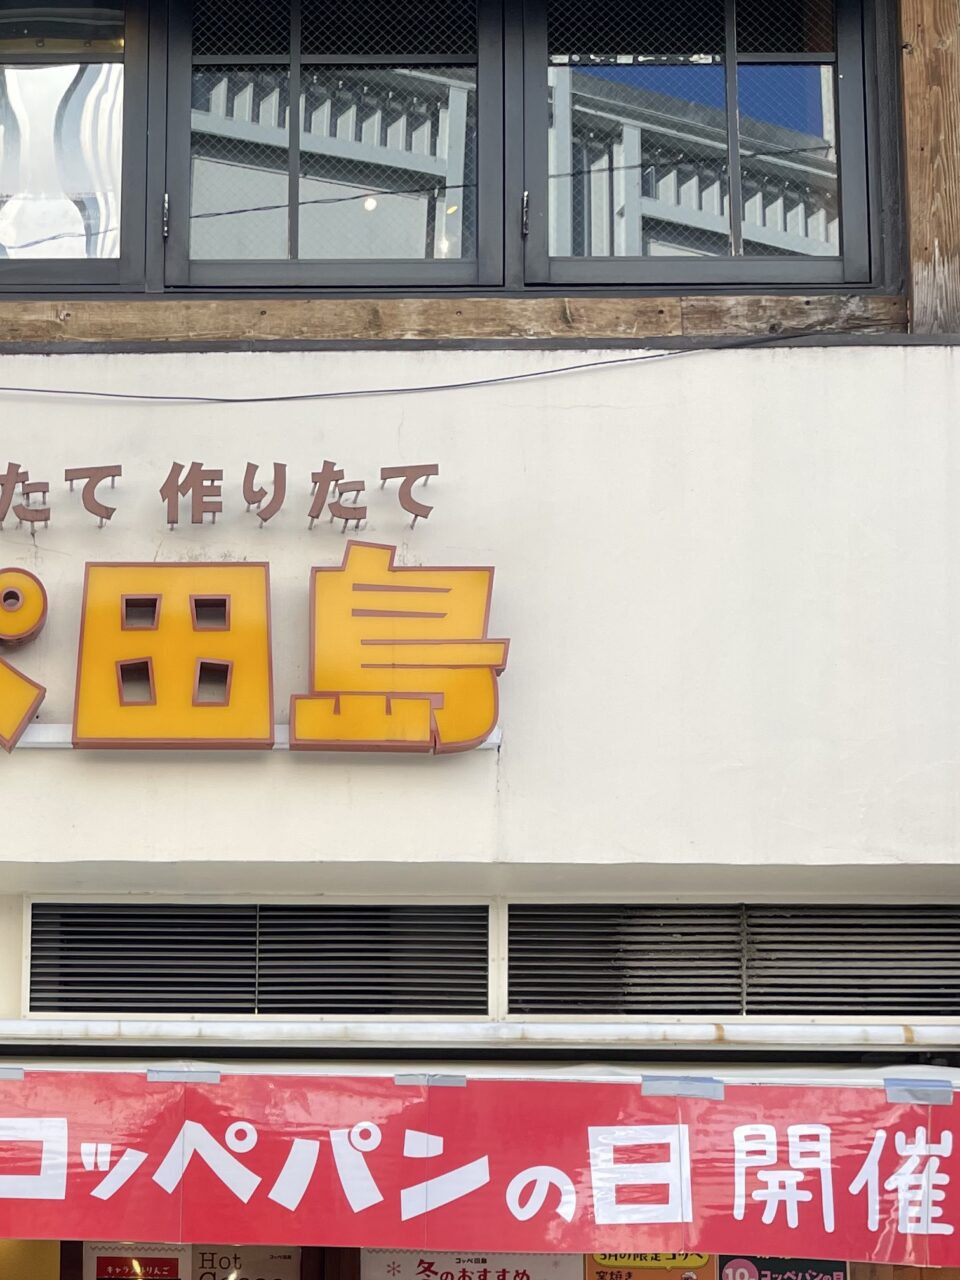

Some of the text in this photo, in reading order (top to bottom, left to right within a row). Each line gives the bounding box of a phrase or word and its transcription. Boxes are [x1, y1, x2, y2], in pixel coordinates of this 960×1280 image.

[160, 462, 441, 523] 作りたて
[198, 1252, 243, 1270] Hot
